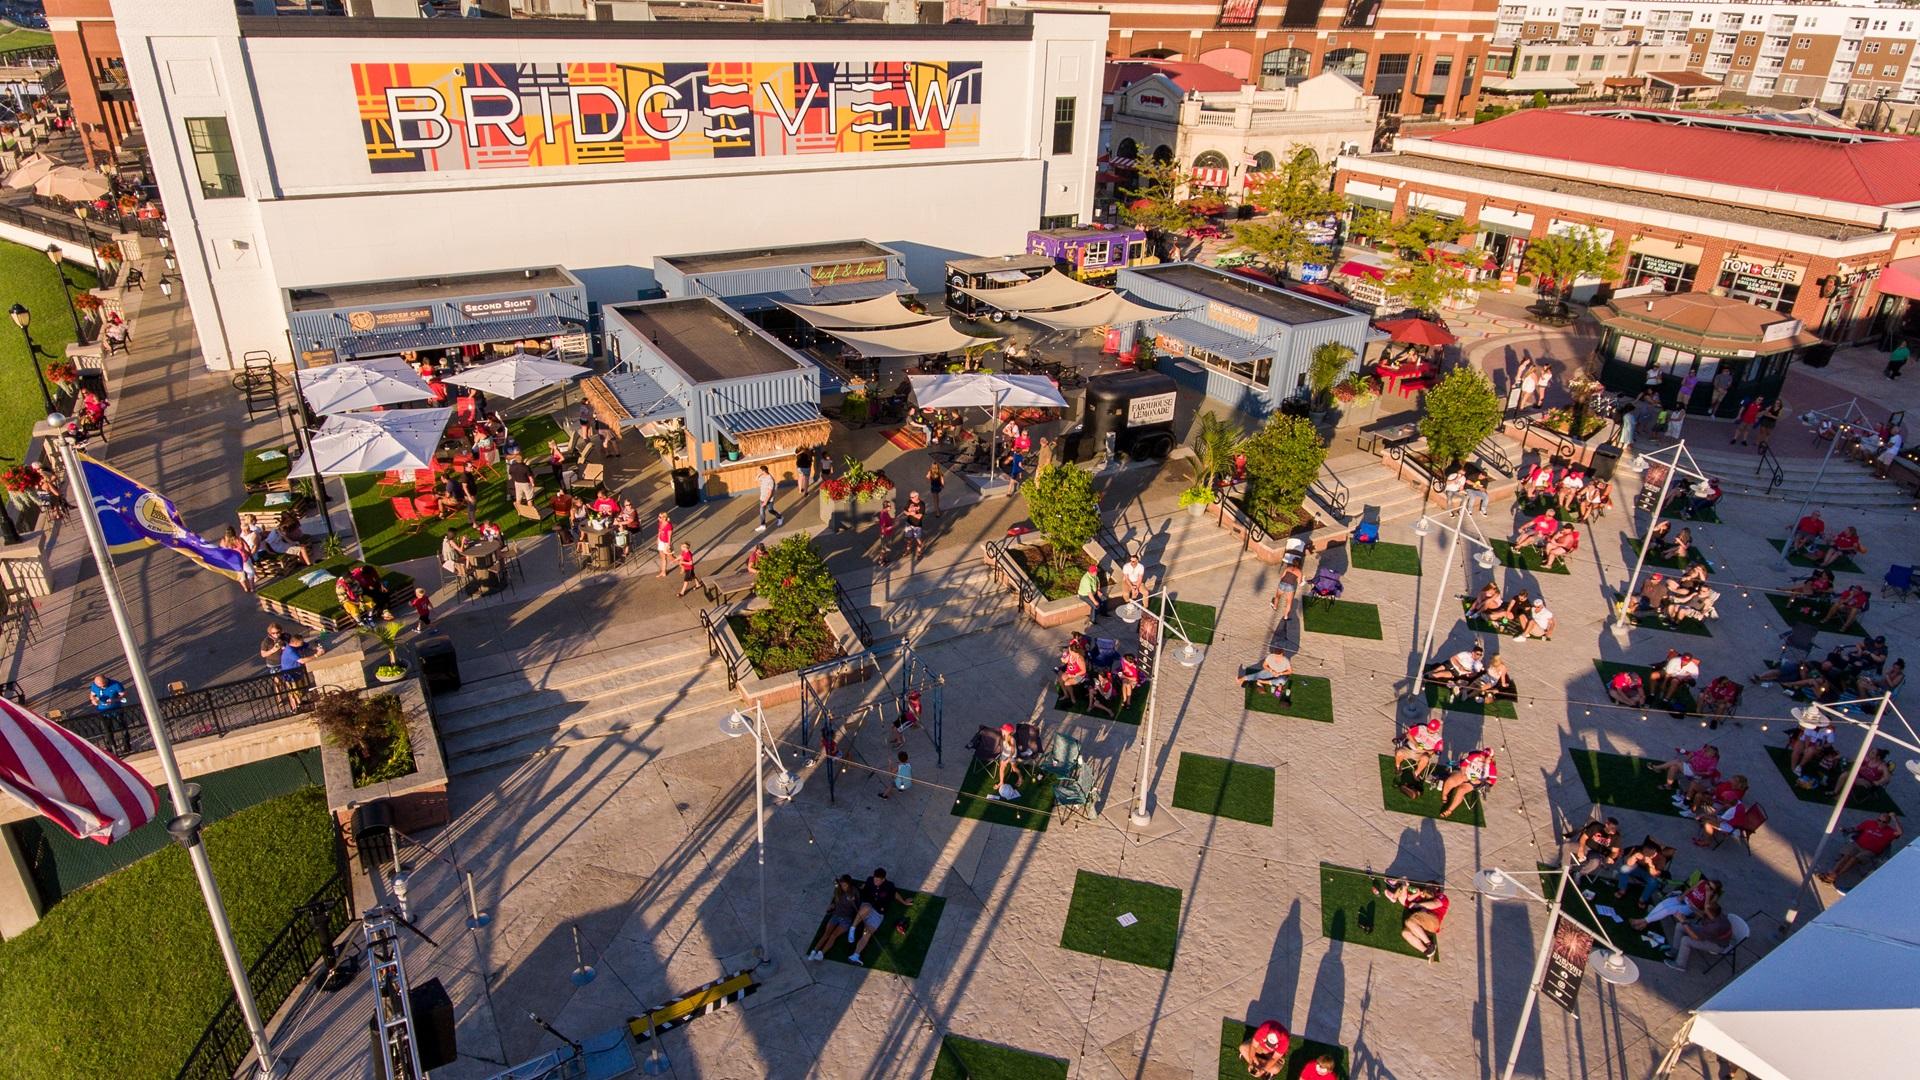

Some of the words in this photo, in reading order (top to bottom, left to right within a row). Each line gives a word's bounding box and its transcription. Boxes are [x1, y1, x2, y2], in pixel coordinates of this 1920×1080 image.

[816, 265, 839, 285] leaf
[841, 263, 852, 277] &
[854, 260, 884, 276] limb
[1131, 398, 1173, 412] FARMHOUSE
[1132, 406, 1170, 419] LEMONADE
